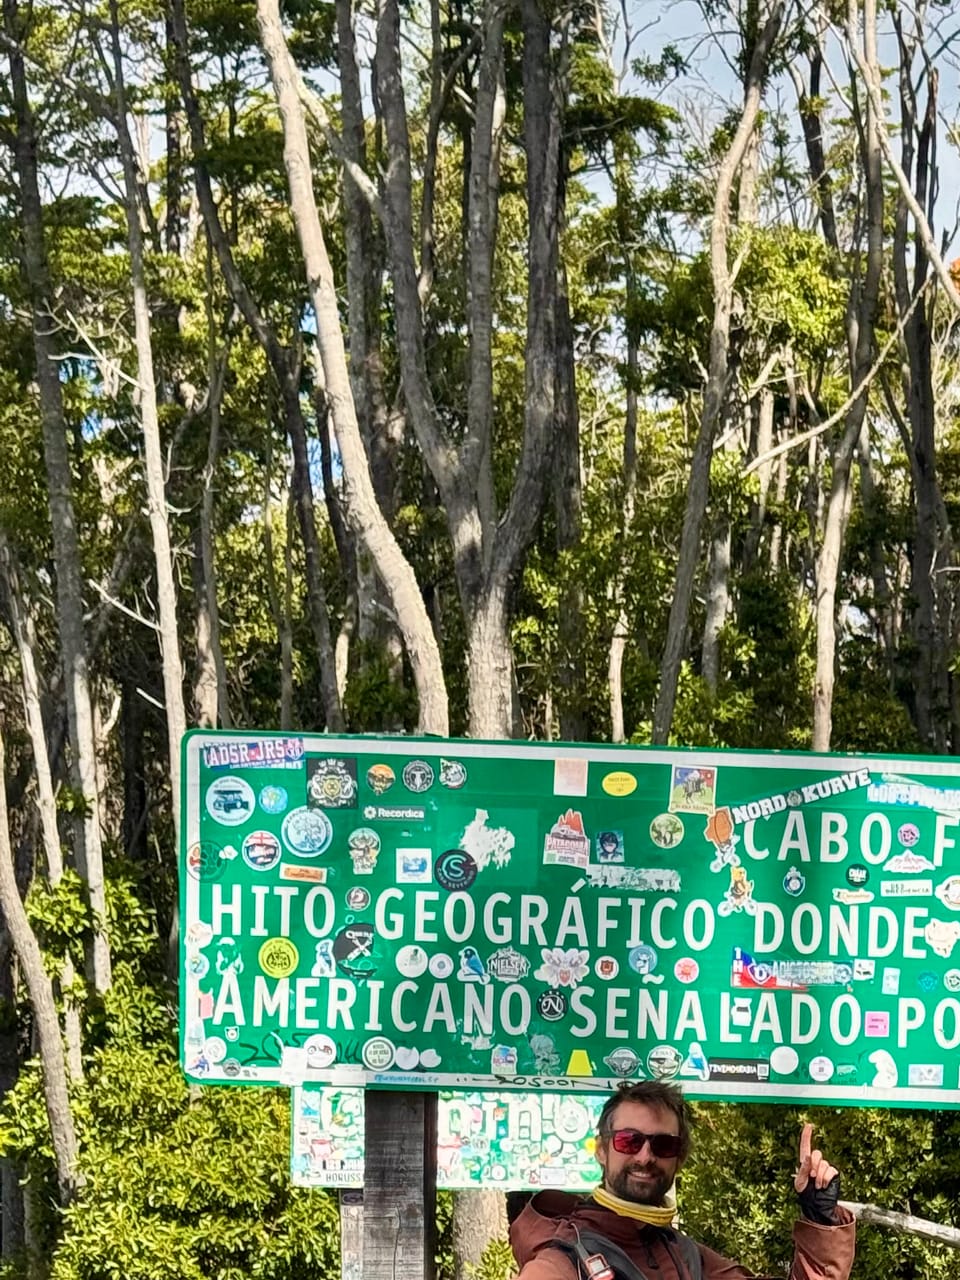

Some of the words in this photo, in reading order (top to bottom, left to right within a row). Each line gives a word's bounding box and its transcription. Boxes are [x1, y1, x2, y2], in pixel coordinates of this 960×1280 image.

[732, 793, 788, 824] NORD
[801, 769, 872, 803] KURVE
[743, 810, 892, 865] CABO
[212, 884, 336, 938] HITO
[375, 878, 715, 951] GEOGRÁFICO
[754, 903, 929, 959] DONDE
[490, 958, 527, 974] NIELSEN
[212, 972, 532, 1036] AMERICANO
[569, 974, 862, 1046] SEÑALADO
